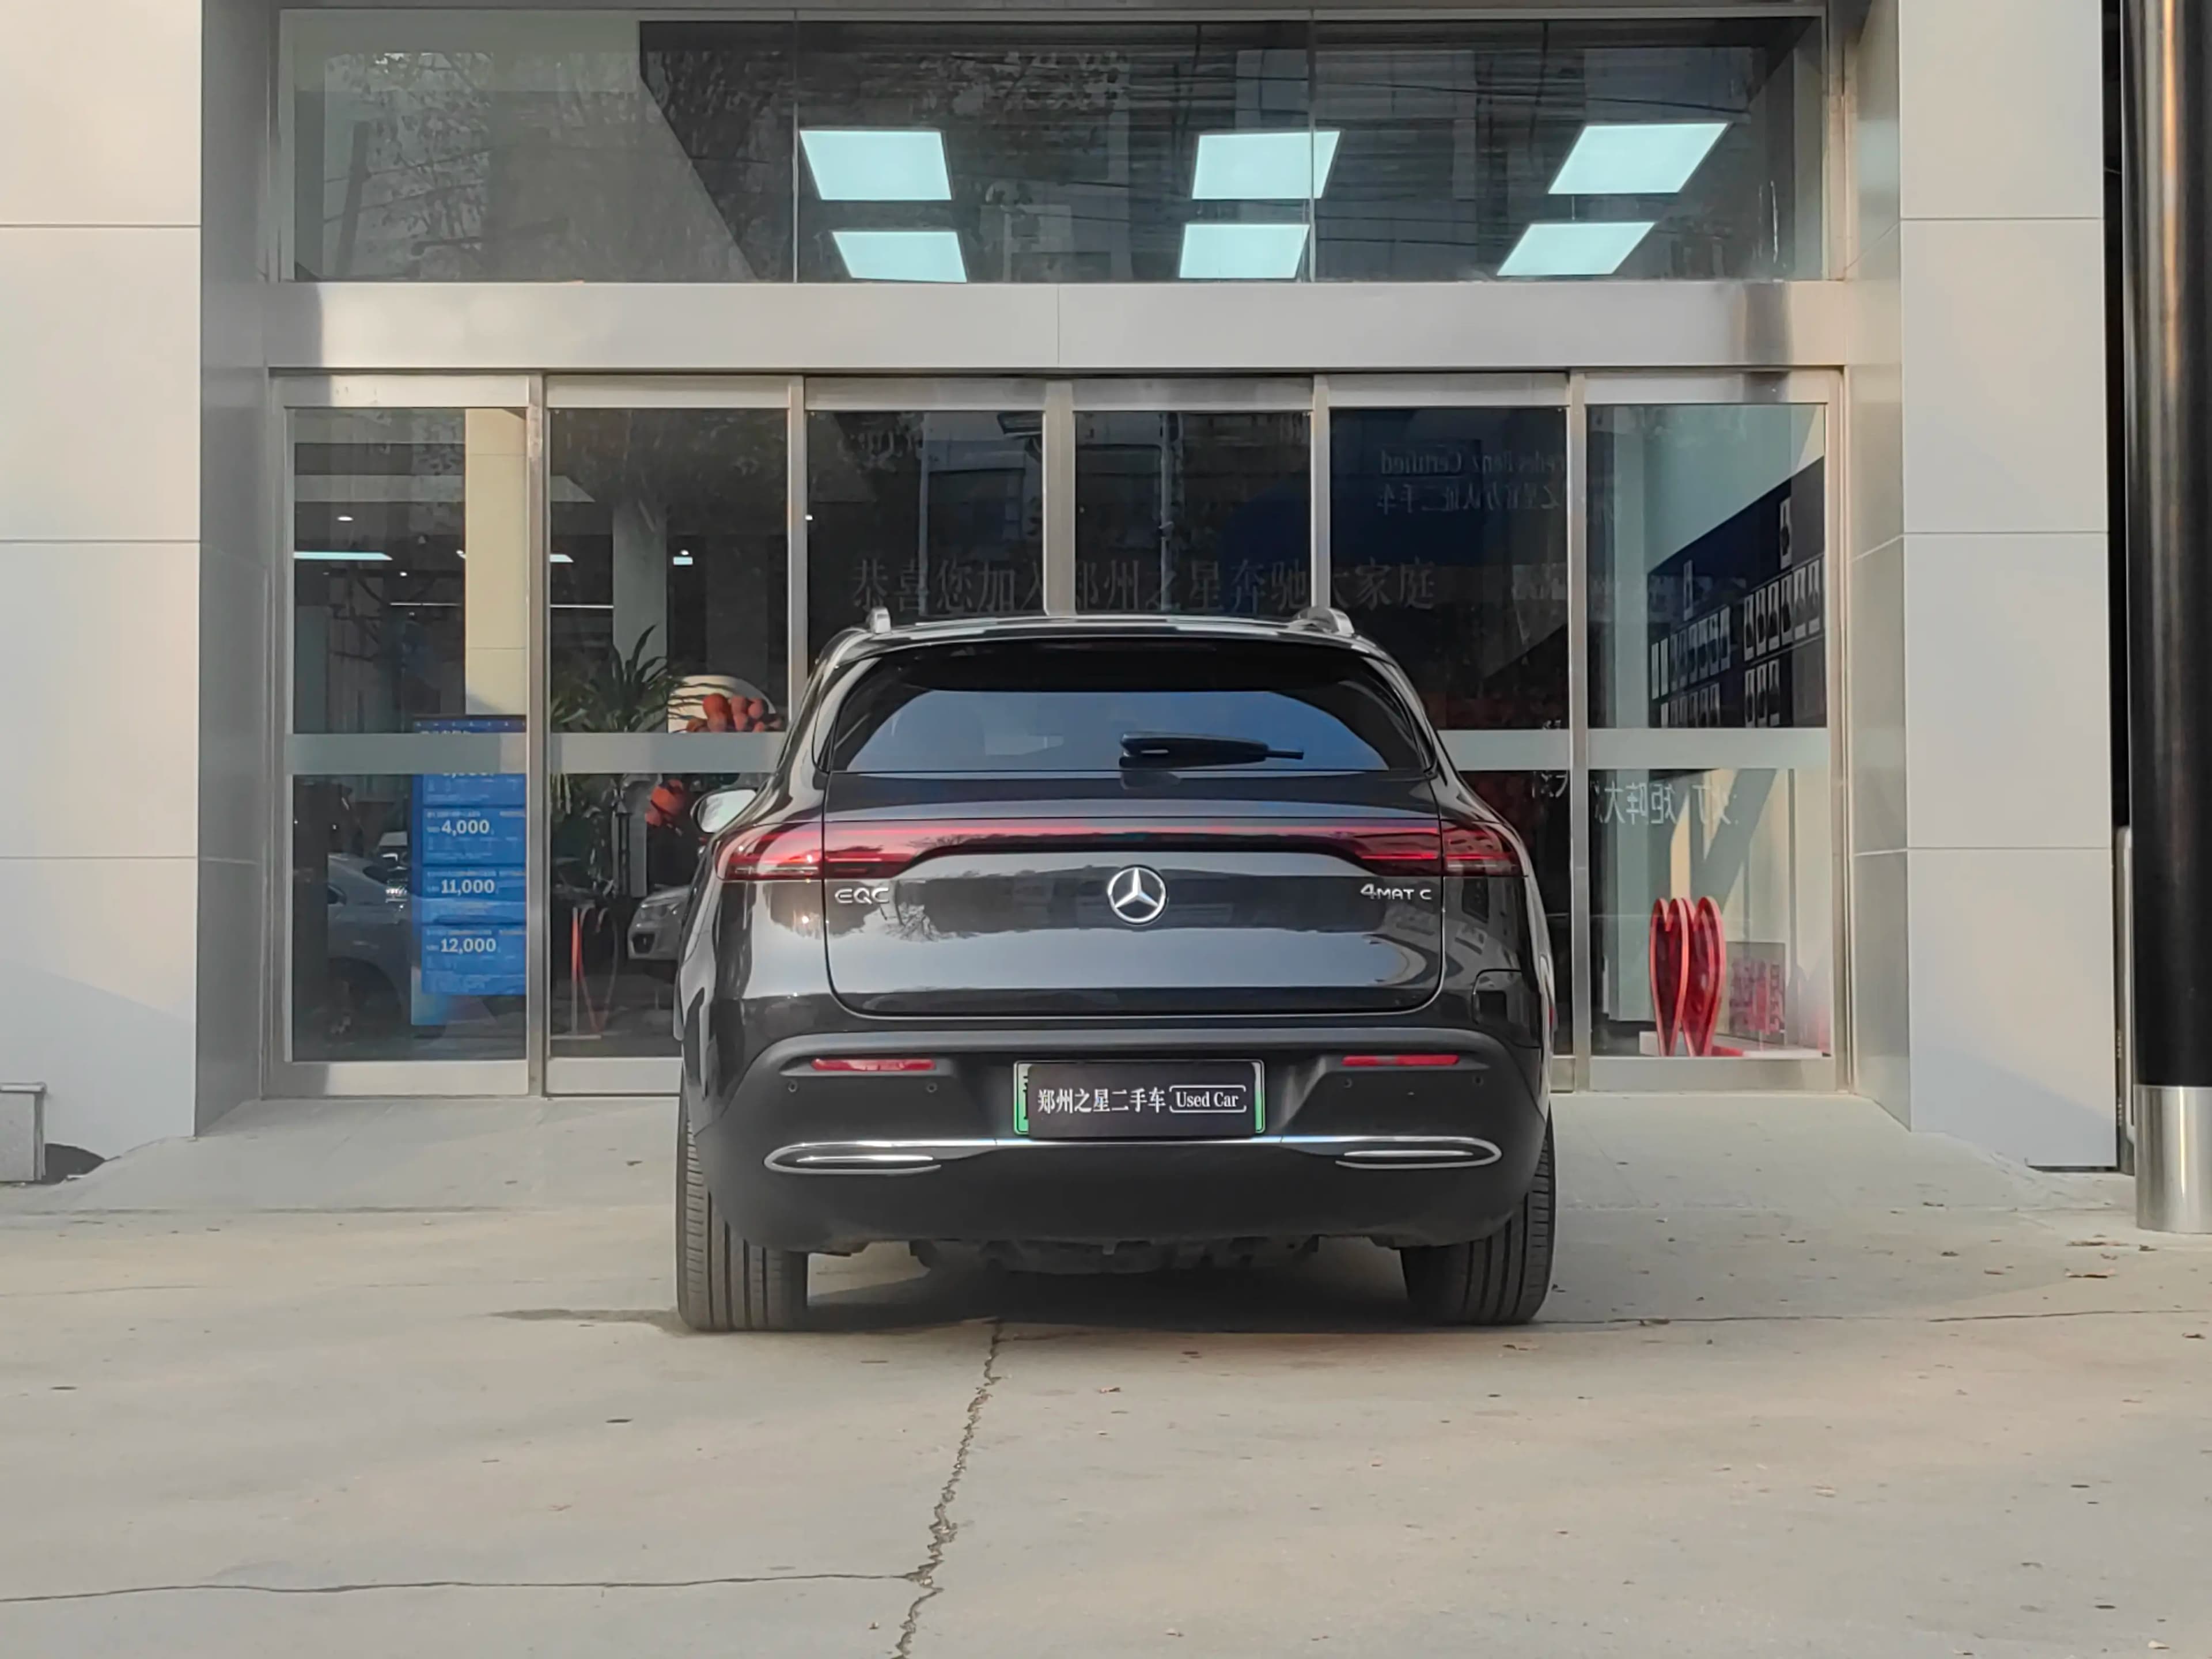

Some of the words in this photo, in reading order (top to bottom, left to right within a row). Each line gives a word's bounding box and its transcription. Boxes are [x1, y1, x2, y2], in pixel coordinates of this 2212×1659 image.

[441, 819, 490, 836] 4,000
[441, 878, 495, 896] 11,000
[834, 887, 889, 904] EQC
[440, 937, 497, 955] 12,000
[1037, 1087, 1166, 1113] 郑州之星二手车
[1176, 1091, 1210, 1108] Used
[1213, 1092, 1239, 1107] Car
